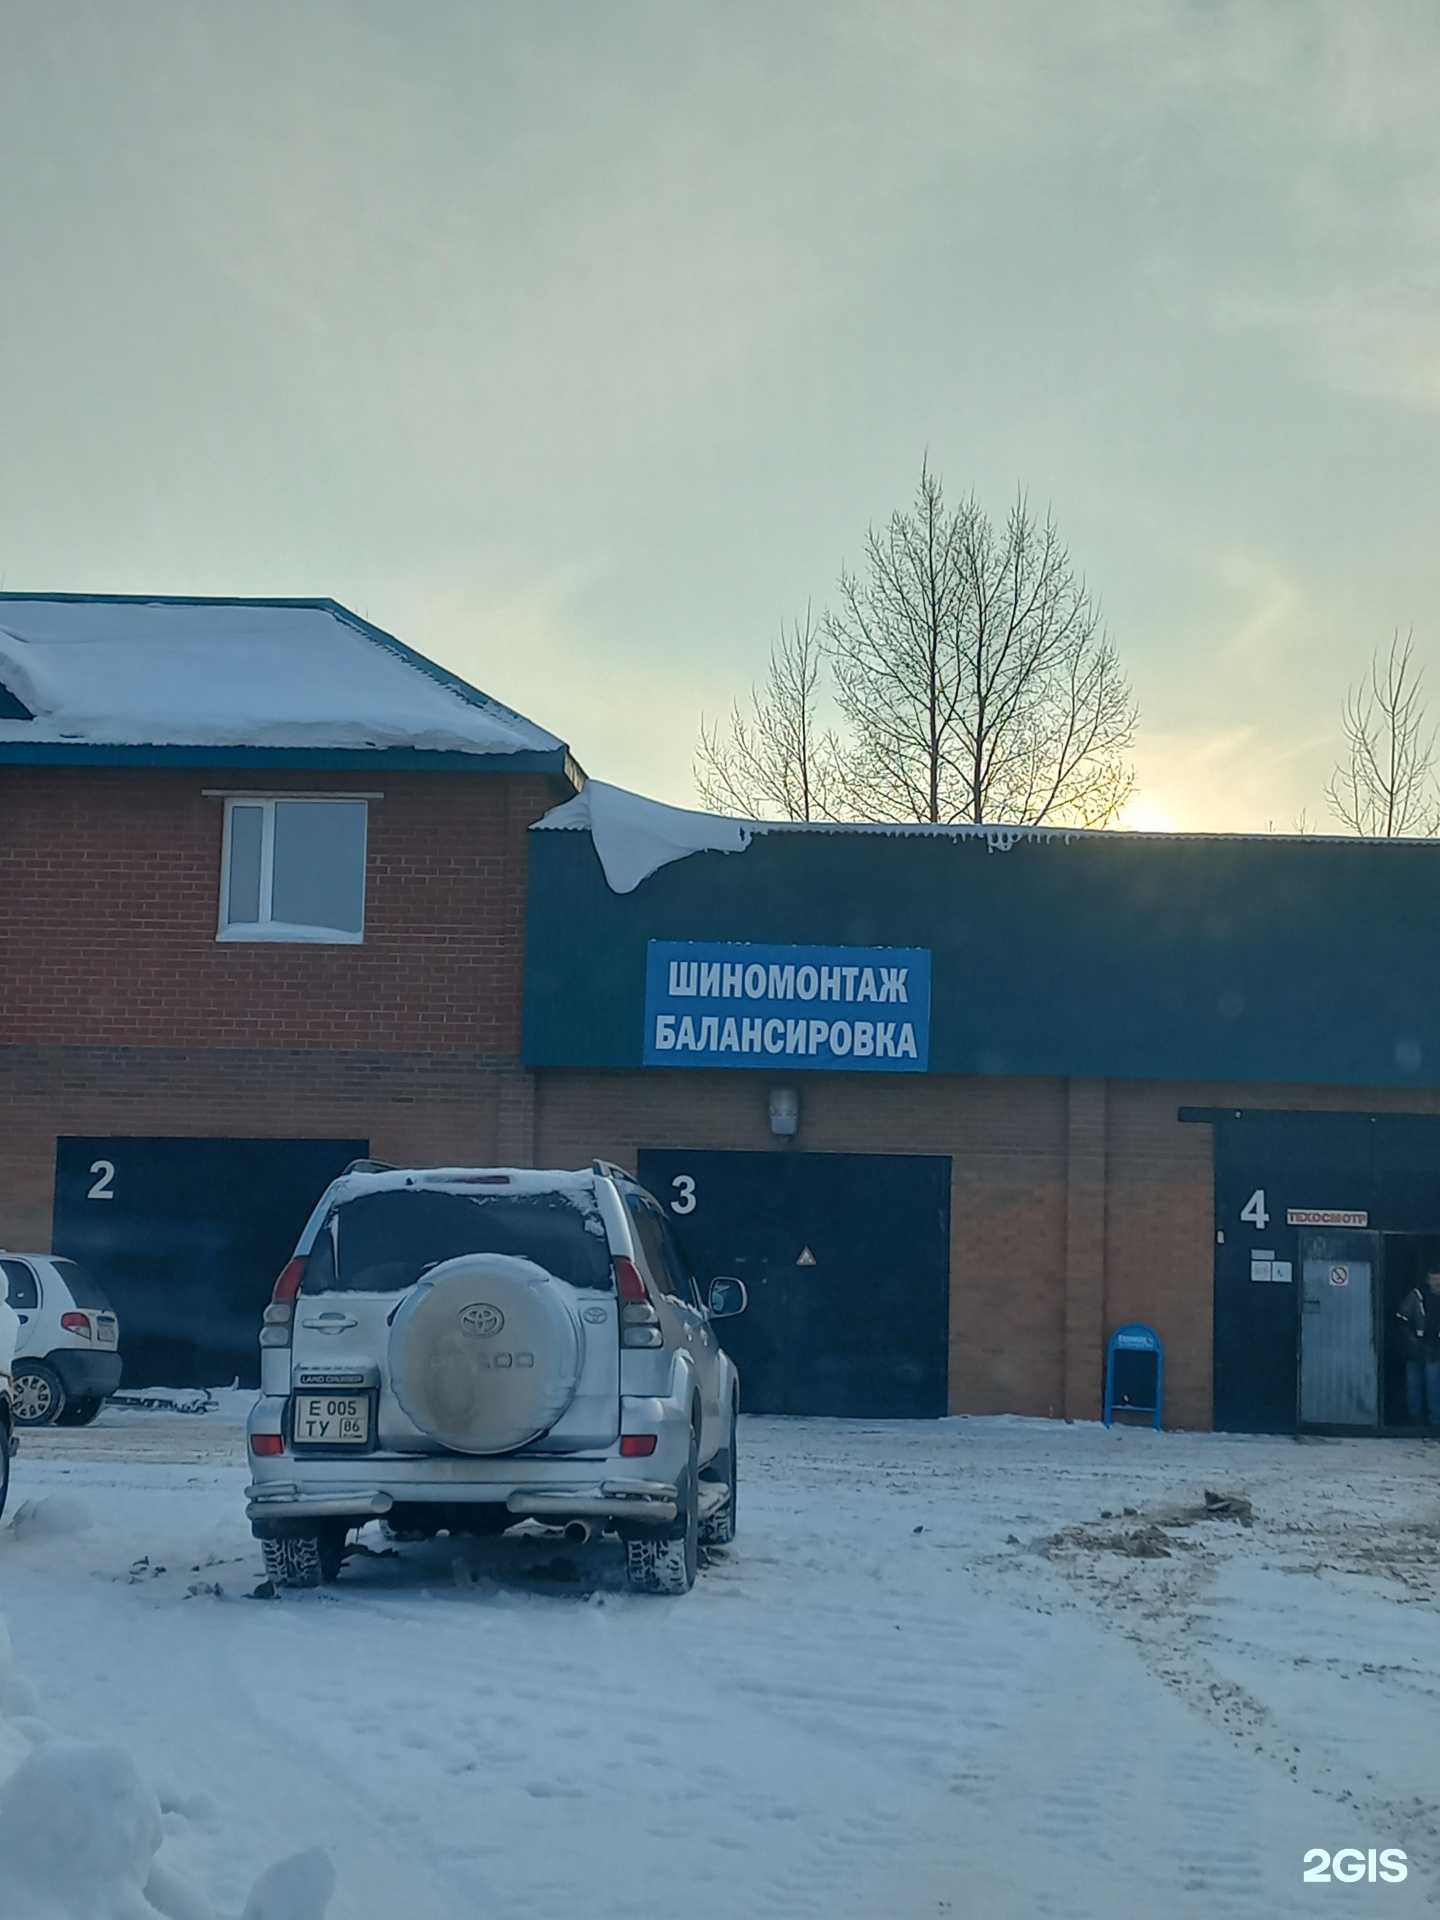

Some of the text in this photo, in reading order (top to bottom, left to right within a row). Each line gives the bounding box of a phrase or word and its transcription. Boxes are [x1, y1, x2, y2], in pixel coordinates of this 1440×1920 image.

[668, 961, 909, 1003] ШИНОМОНТАЖ
[655, 1015, 918, 1058] БАЛАНСИРОВКА
[87, 1160, 116, 1199] 2
[670, 1175, 697, 1214] 3
[1240, 1189, 1270, 1229] 4
[1289, 1212, 1366, 1225] ТЕХОСМОТР
[327, 1401, 357, 1416] 005
[343, 1421, 360, 1432] 86
